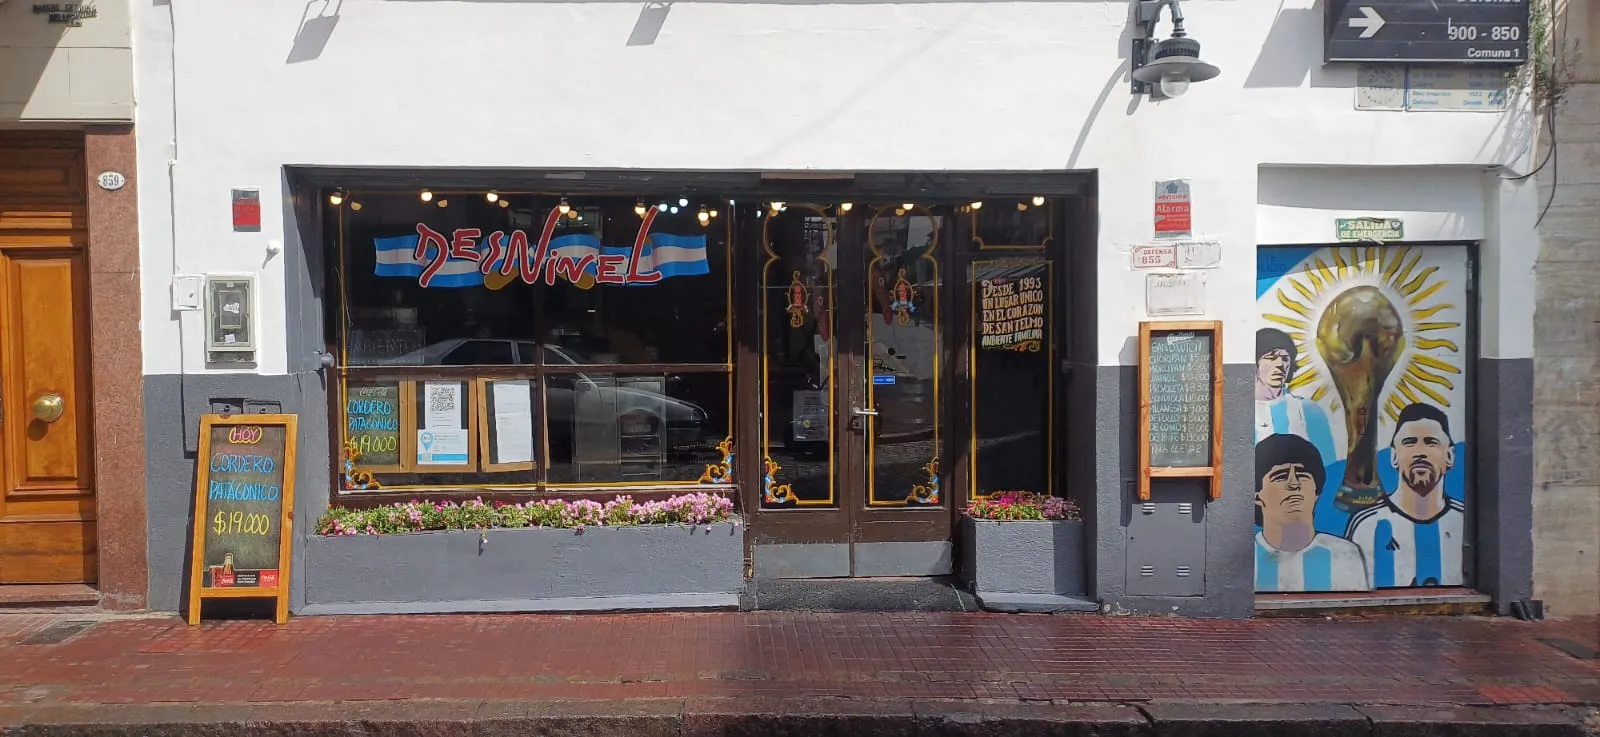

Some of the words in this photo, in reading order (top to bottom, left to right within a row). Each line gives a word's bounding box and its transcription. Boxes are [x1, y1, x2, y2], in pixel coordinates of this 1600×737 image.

[1449, 26, 1477, 40] 900
[1491, 26, 1520, 40] 850
[1467, 48, 1511, 57] Comuna
[1513, 48, 1520, 57] 1
[102, 174, 120, 187] 859
[1156, 204, 1190, 213] Alarma
[1348, 220, 1391, 230] SALIDA
[1142, 256, 1161, 264] 855
[982, 298, 994, 310] UN
[995, 294, 1019, 309] LUGAR
[1020, 290, 1043, 305] UNICO
[983, 309, 995, 322] EN
[996, 308, 1006, 321] EL
[1007, 303, 1044, 320] CORAZON
[982, 322, 995, 335] DE
[995, 320, 1014, 334] SAN
[1014, 316, 1044, 331] TELMO
[982, 334, 1013, 347] AMBIENTE
[347, 399, 392, 416] CORDERO
[348, 416, 398, 431] PATAGONICO
[232, 428, 258, 441] HOY
[210, 453, 275, 473] CORDERO
[208, 479, 279, 501] PATAGONICO
